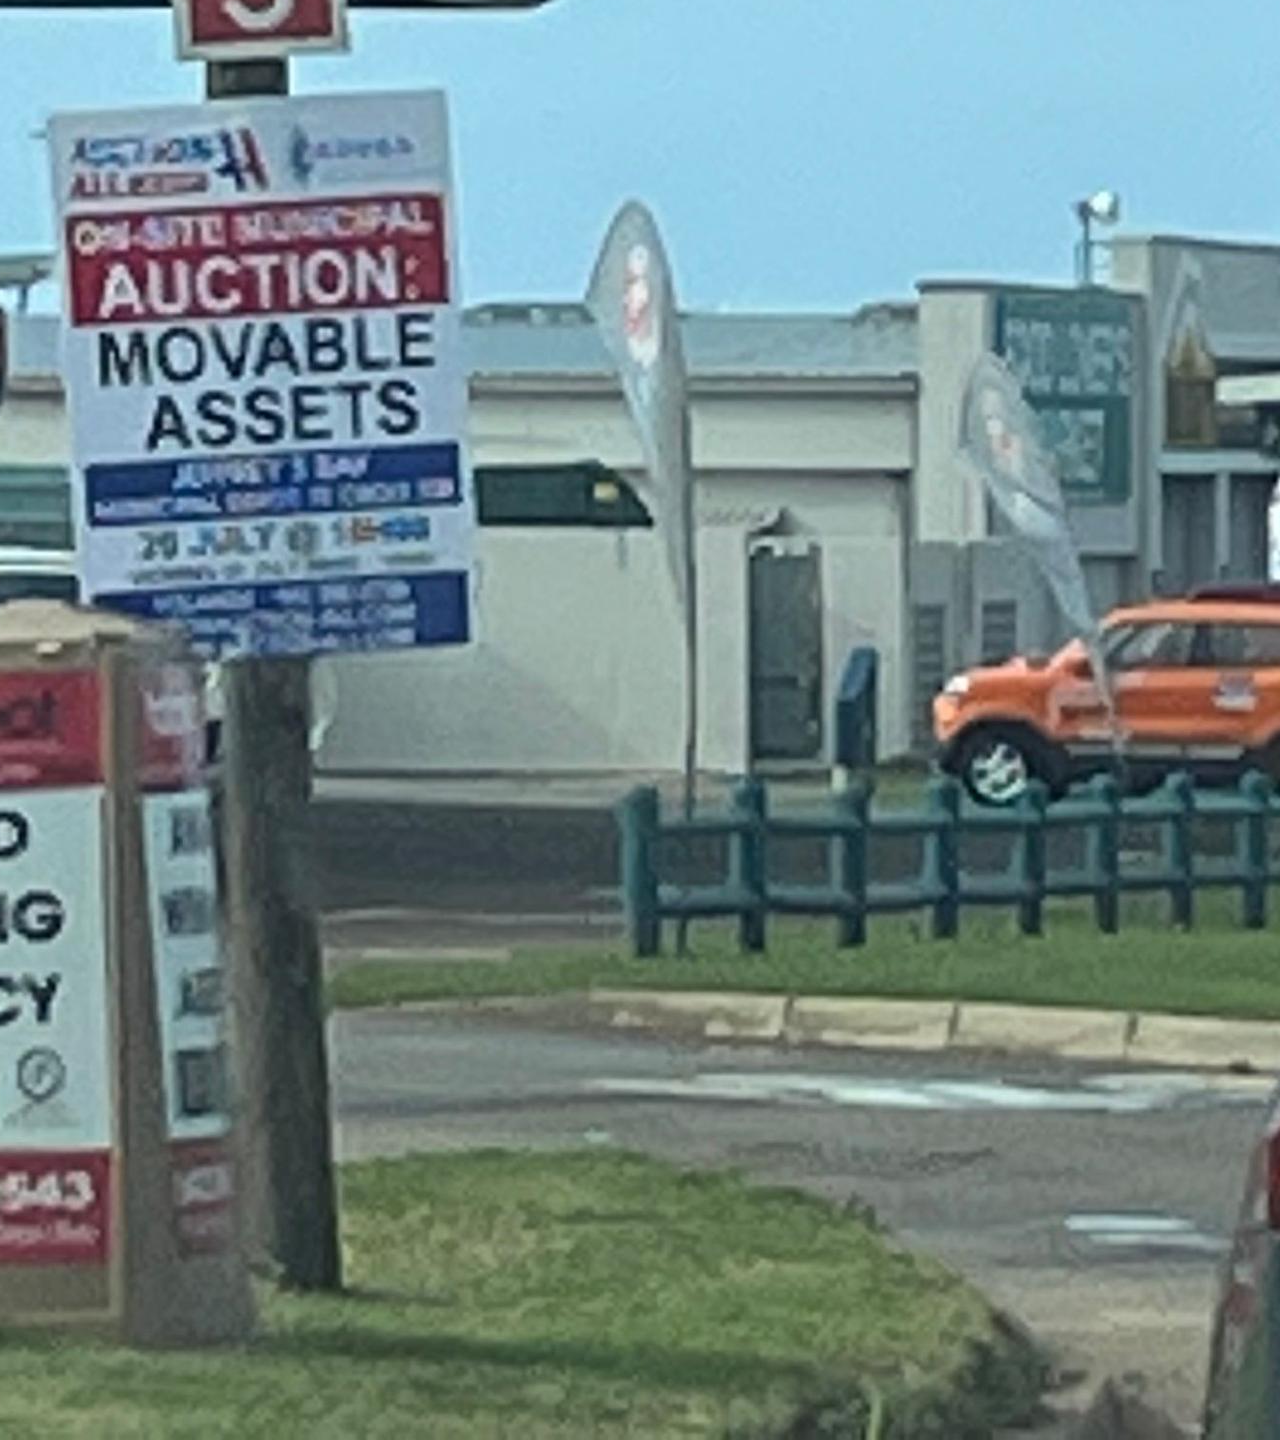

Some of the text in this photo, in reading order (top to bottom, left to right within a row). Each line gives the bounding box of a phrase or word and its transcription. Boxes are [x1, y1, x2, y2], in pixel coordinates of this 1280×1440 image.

[231, 200, 435, 244] MUNICIPAL
[97, 250, 420, 320] AUCTION:
[98, 313, 436, 387] MOVABLE
[146, 380, 421, 451] ASSETS
